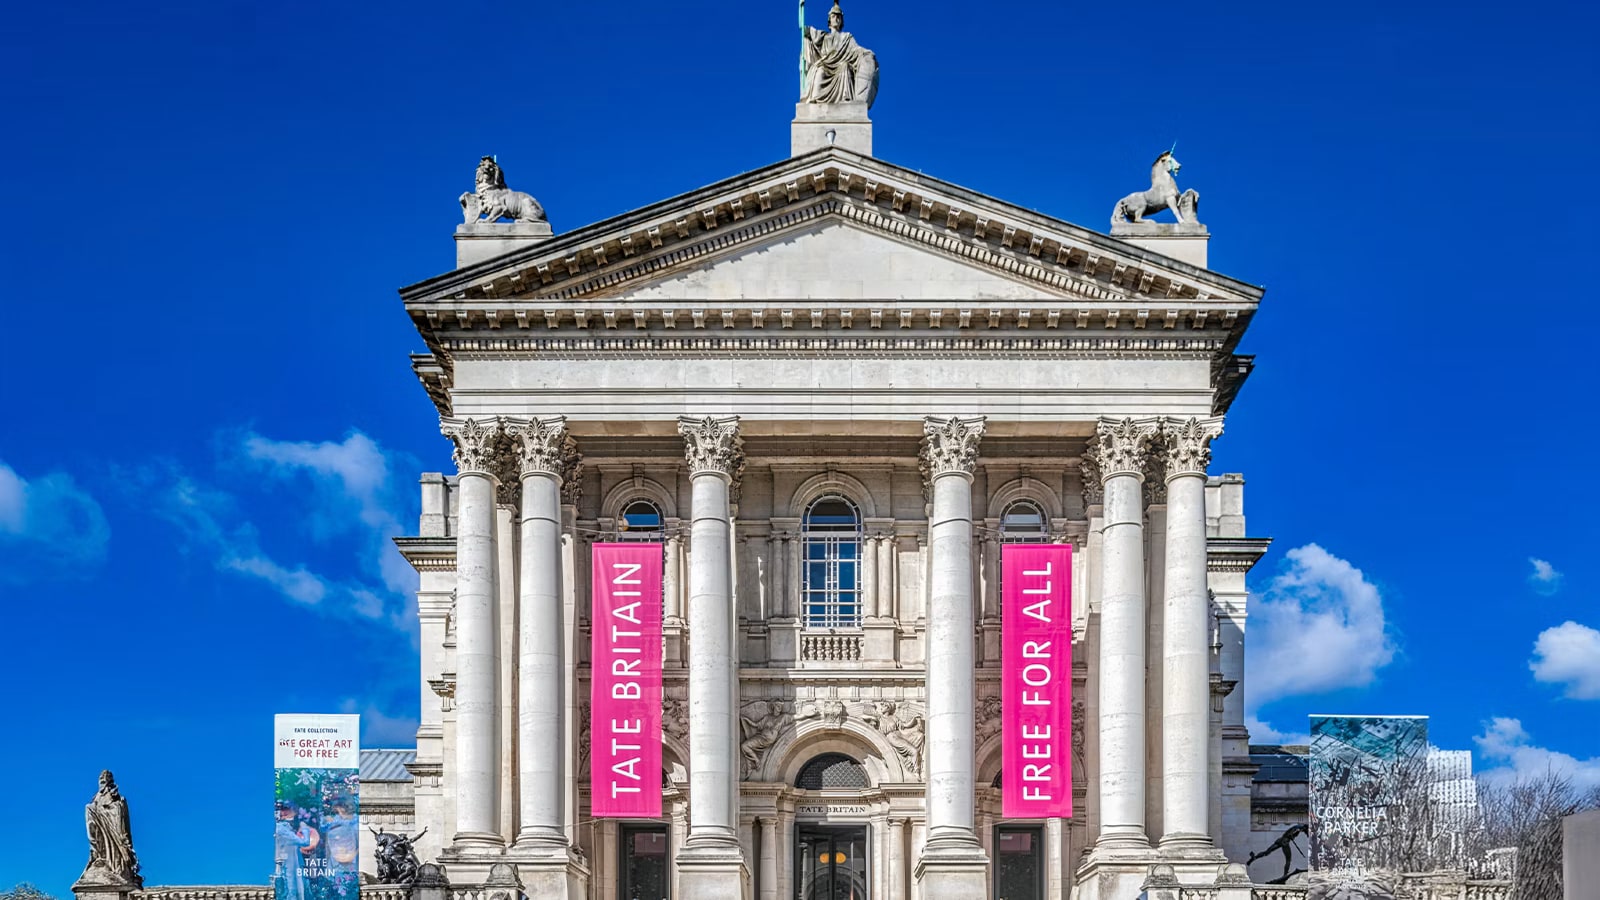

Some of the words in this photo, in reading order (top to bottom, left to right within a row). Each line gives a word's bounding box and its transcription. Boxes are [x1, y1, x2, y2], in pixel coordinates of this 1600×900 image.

[1022, 561, 1052, 622] ALL
[612, 563, 641, 699] BRITAIN
[1022, 641, 1051, 705] FOR
[299, 739, 330, 748] GREAT
[333, 739, 353, 748] ART
[294, 749, 313, 758] FOR
[316, 749, 339, 758] FREE
[612, 719, 641, 799] TATE
[1022, 724, 1052, 801] FREE
[1316, 806, 1387, 819] CORNELIA
[1324, 821, 1378, 834] PARKER
[304, 858, 328, 867] TATE
[296, 867, 336, 877] BRITAIN
